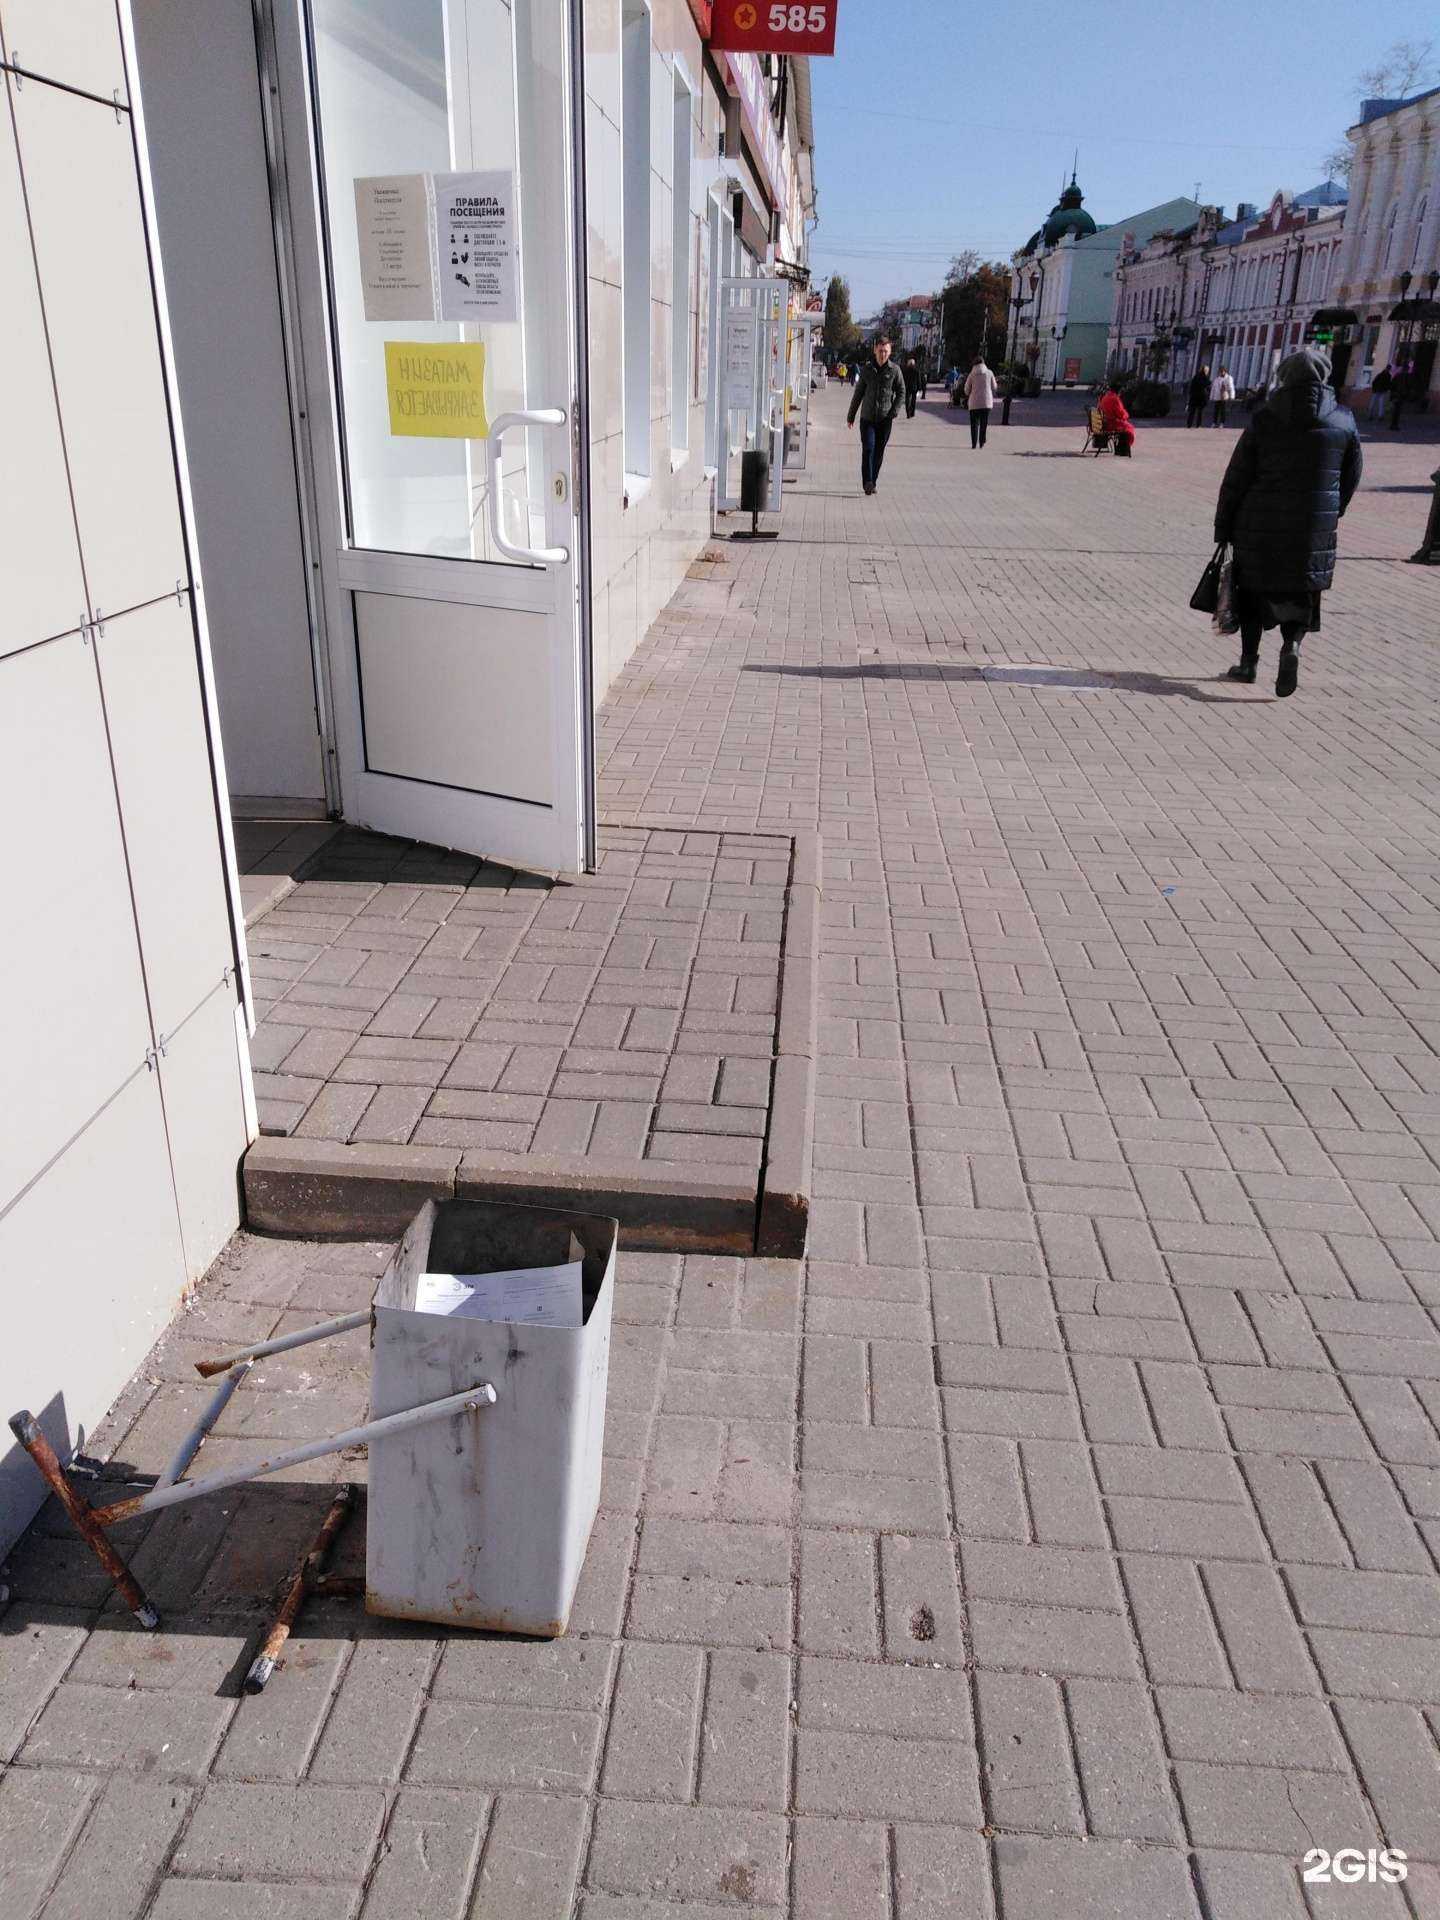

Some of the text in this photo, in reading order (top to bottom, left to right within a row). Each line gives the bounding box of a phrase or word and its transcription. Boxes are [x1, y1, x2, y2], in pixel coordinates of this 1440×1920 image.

[768, 4, 826, 33] 585
[455, 197, 499, 207] ПРАВИЛА
[449, 207, 505, 218] ПОСЕЩЕНИЯ
